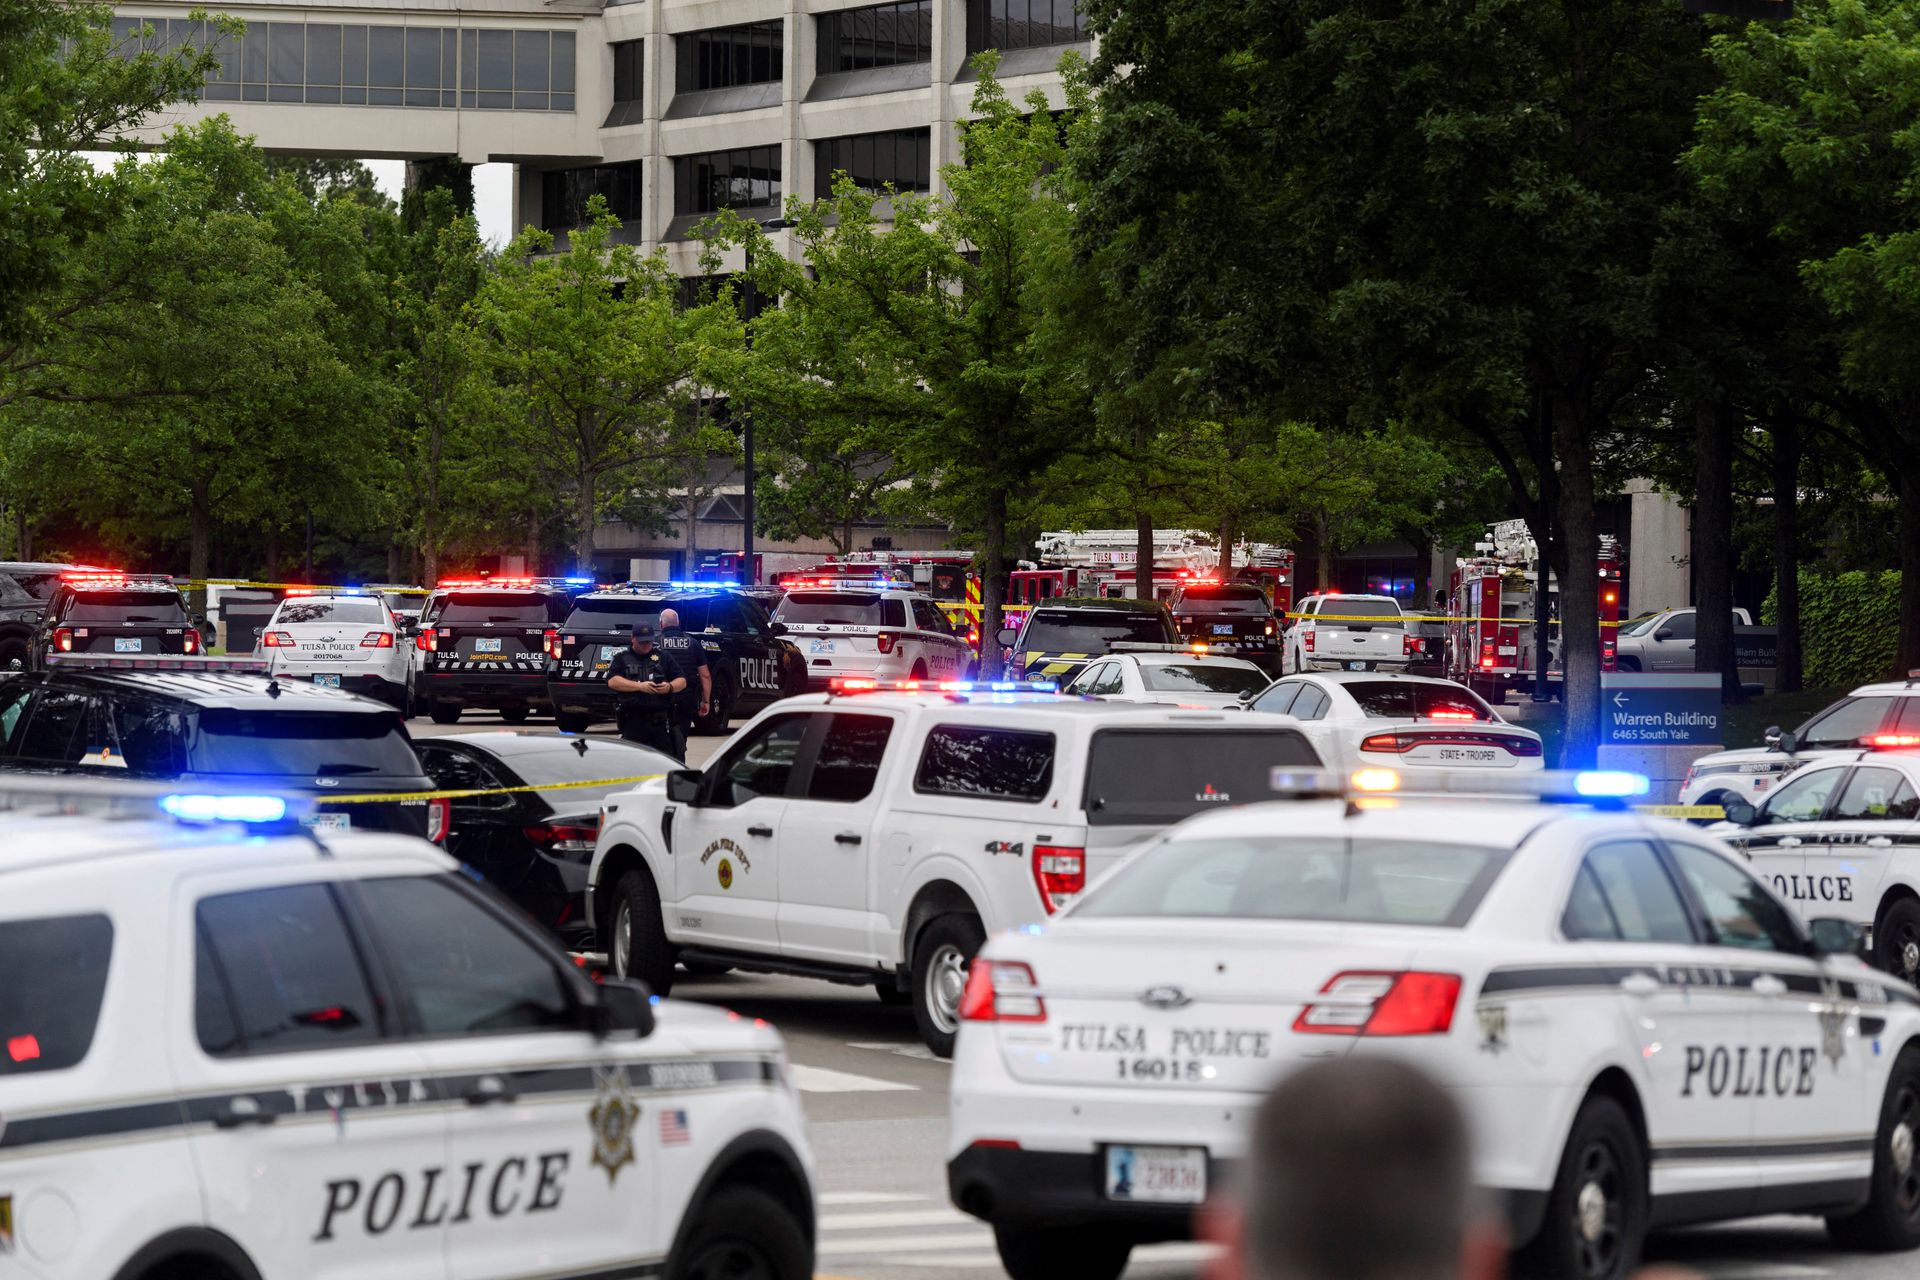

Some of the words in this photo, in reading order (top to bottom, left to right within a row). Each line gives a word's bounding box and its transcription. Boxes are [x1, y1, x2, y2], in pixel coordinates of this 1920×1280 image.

[787, 624, 805, 632] ULSA
[842, 625, 869, 633] POLICE
[300, 643, 327, 651] TULSA
[329, 643, 356, 651] POLICE
[663, 637, 688, 649] POLICE
[437, 651, 459, 659] TULSA
[515, 652, 543, 660] POLICE
[561, 659, 584, 668] TULSA
[739, 657, 780, 690] POLICE
[1613, 711, 1662, 726] Warren
[1664, 711, 1717, 729] Building
[1612, 729, 1638, 740] 6465
[1639, 728, 1668, 740] South
[1670, 729, 1690, 740] Yale
[1440, 749, 1460, 760] STATE
[1466, 750, 1496, 761] TROOPER
[700, 839, 719, 866] TULSA
[1763, 873, 1853, 902] OLICE
[1061, 1023, 1147, 1054] TULSA
[1170, 1028, 1272, 1059] POLICE
[1679, 1045, 1818, 1099] POLICE
[312, 1150, 571, 1244] POLICE
